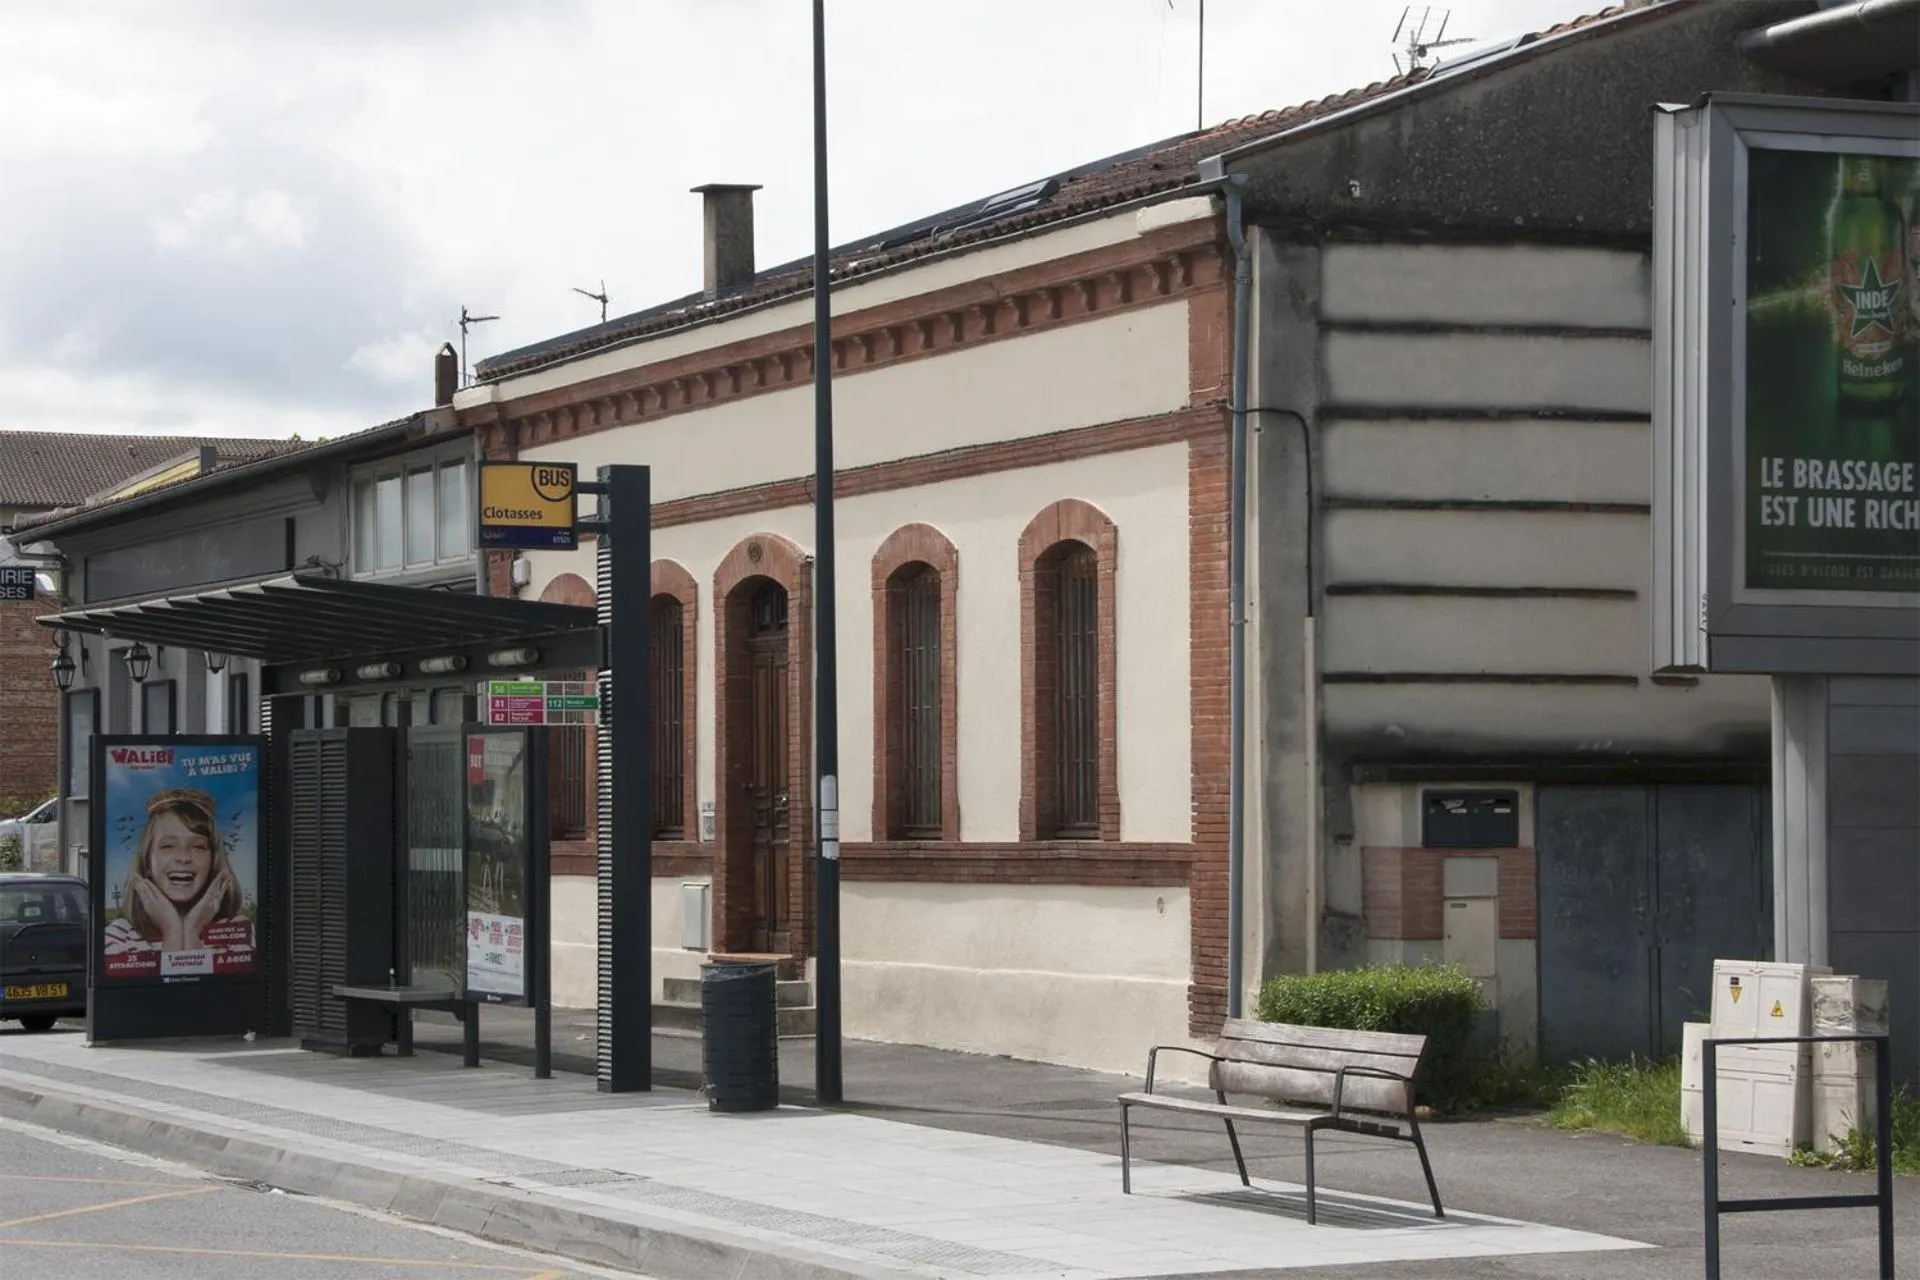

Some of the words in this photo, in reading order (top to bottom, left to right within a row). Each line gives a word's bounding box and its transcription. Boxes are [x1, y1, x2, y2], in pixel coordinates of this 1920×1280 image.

[1856, 291, 1888, 309] INDE
[539, 469, 570, 487] BUS
[1761, 457, 1784, 488] LE
[1793, 458, 1914, 492] BRASSAGE
[483, 506, 543, 520] Clotasses
[1761, 495, 1799, 526] EST
[1807, 496, 1856, 528] UNE
